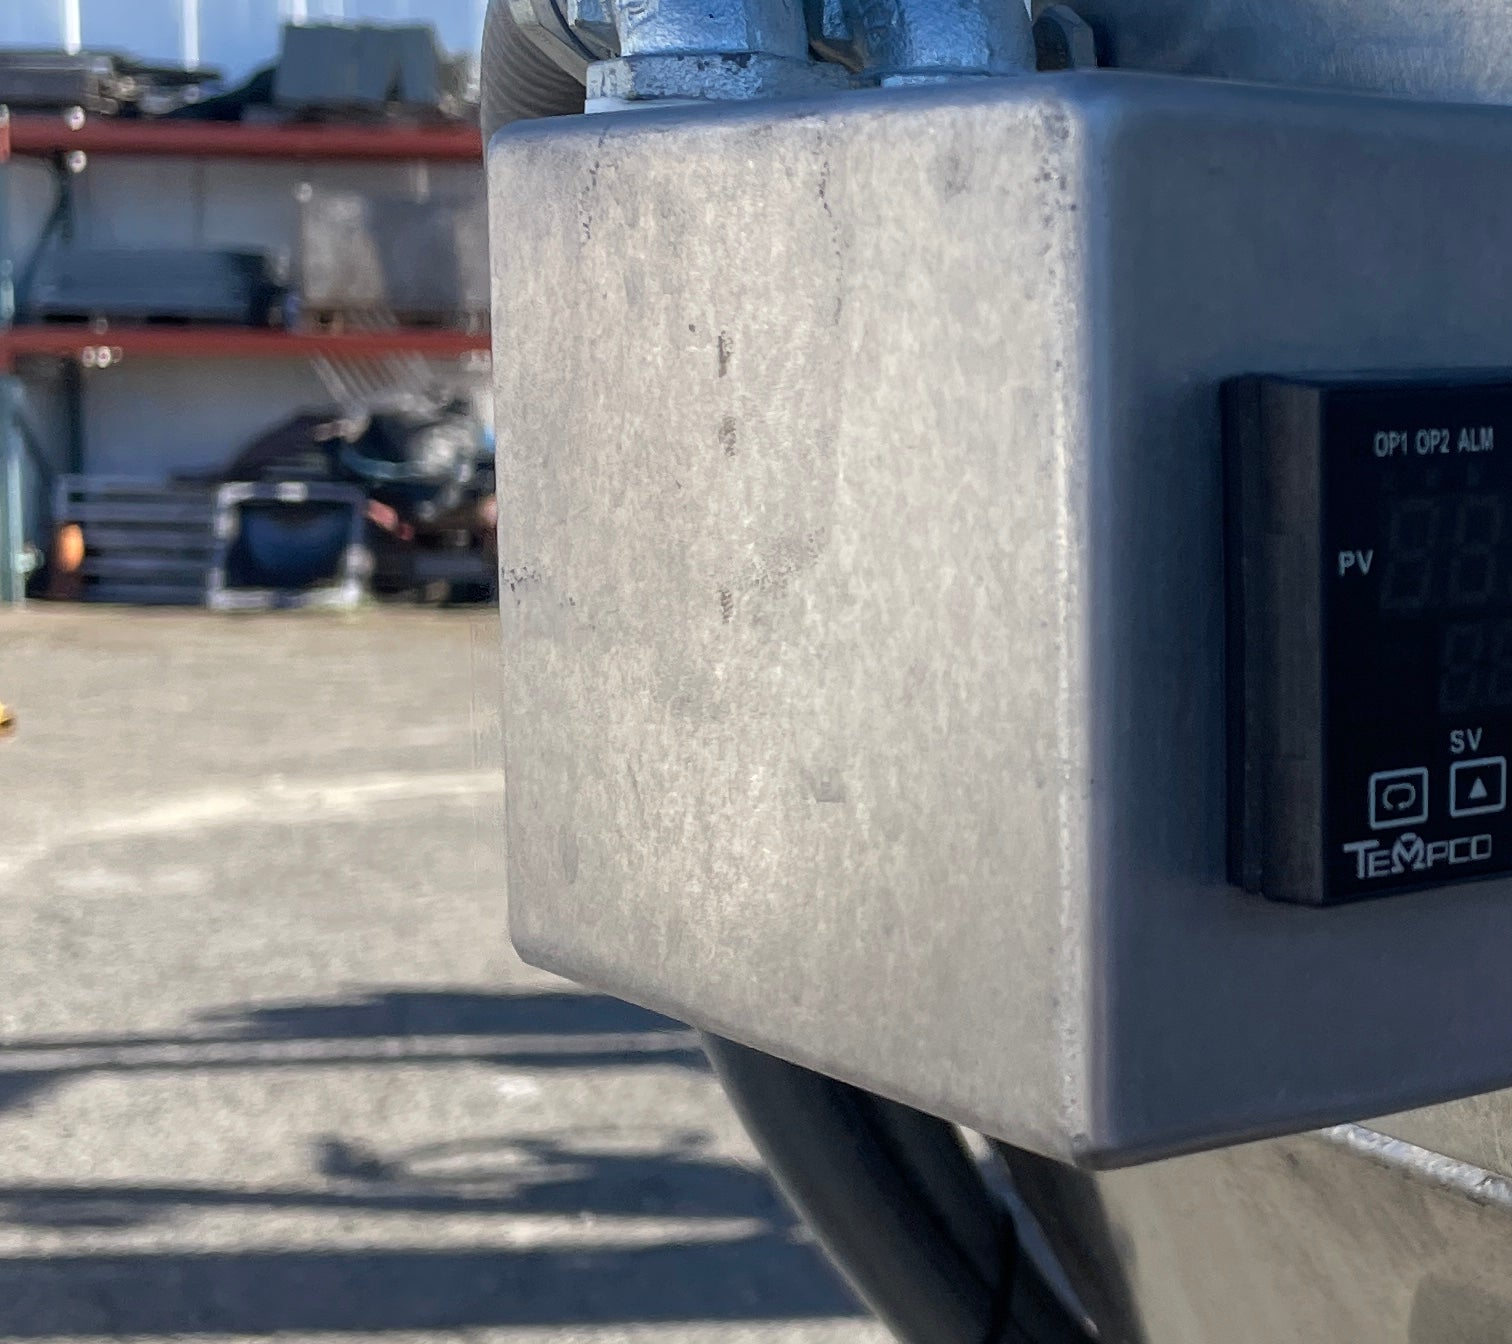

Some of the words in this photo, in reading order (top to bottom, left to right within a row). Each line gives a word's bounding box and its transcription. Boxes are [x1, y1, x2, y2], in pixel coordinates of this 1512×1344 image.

[1374, 430, 1408, 457] OP1
[1415, 428, 1450, 455] OP2
[1458, 426, 1494, 452] ALM
[1338, 549, 1374, 576] PV
[1450, 727, 1483, 754] SV
